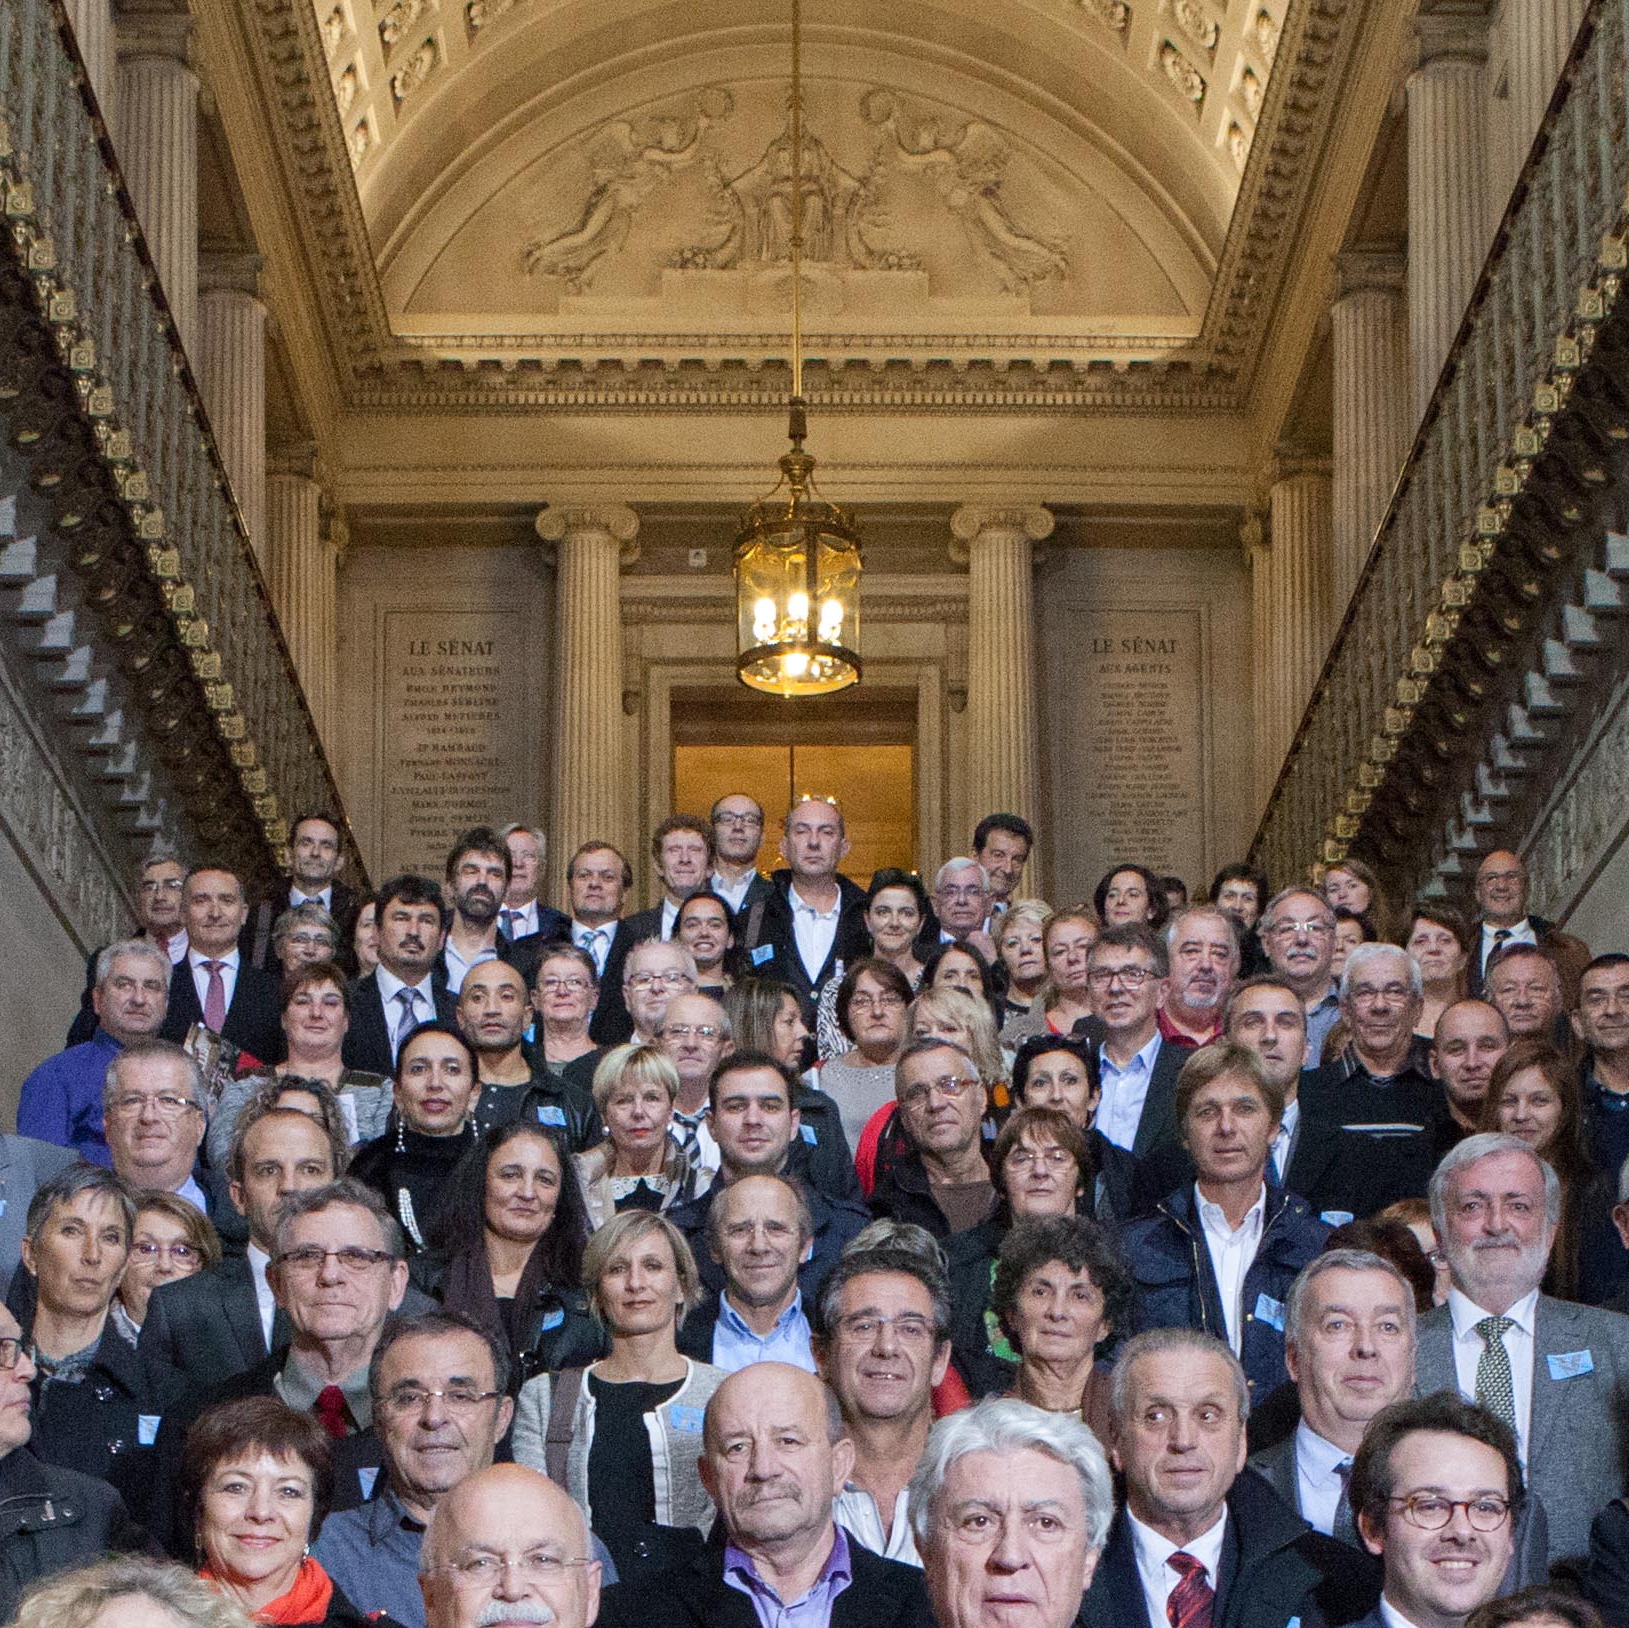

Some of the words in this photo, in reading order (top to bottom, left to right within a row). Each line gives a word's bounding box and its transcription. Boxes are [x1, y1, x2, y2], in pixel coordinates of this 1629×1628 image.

[409, 640, 431, 656] LE
[1092, 638, 1114, 654] LE
[1121, 636, 1177, 654] SÉNAT
